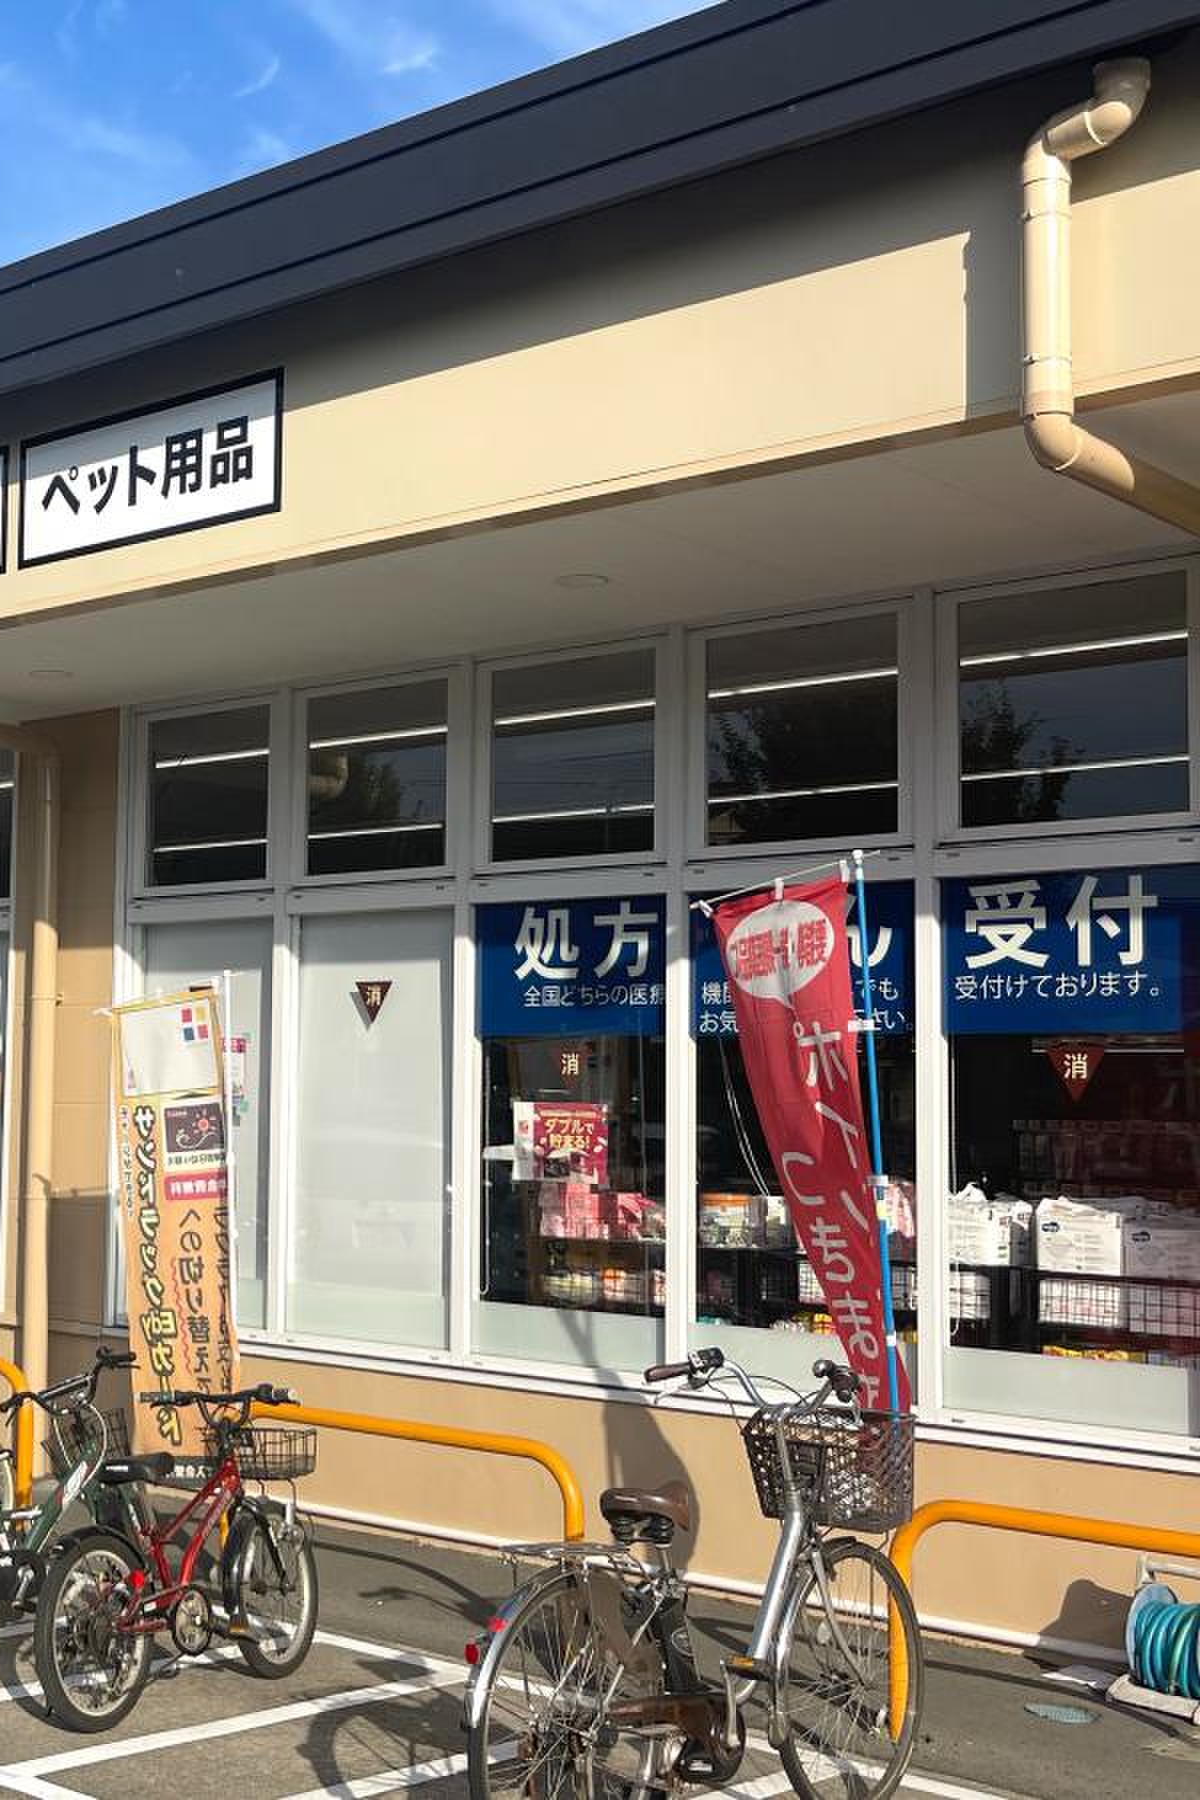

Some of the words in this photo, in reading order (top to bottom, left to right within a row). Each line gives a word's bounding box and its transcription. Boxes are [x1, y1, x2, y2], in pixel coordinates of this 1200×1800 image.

[42, 415, 254, 516] ペット用品
[514, 900, 660, 980] 処方
[964, 874, 1159, 969] 受付
[954, 969, 1161, 1001] 受付けております。
[561, 1053, 581, 1076] 消
[1064, 1053, 1089, 1079] 消
[544, 1118, 595, 1136] ダブルで
